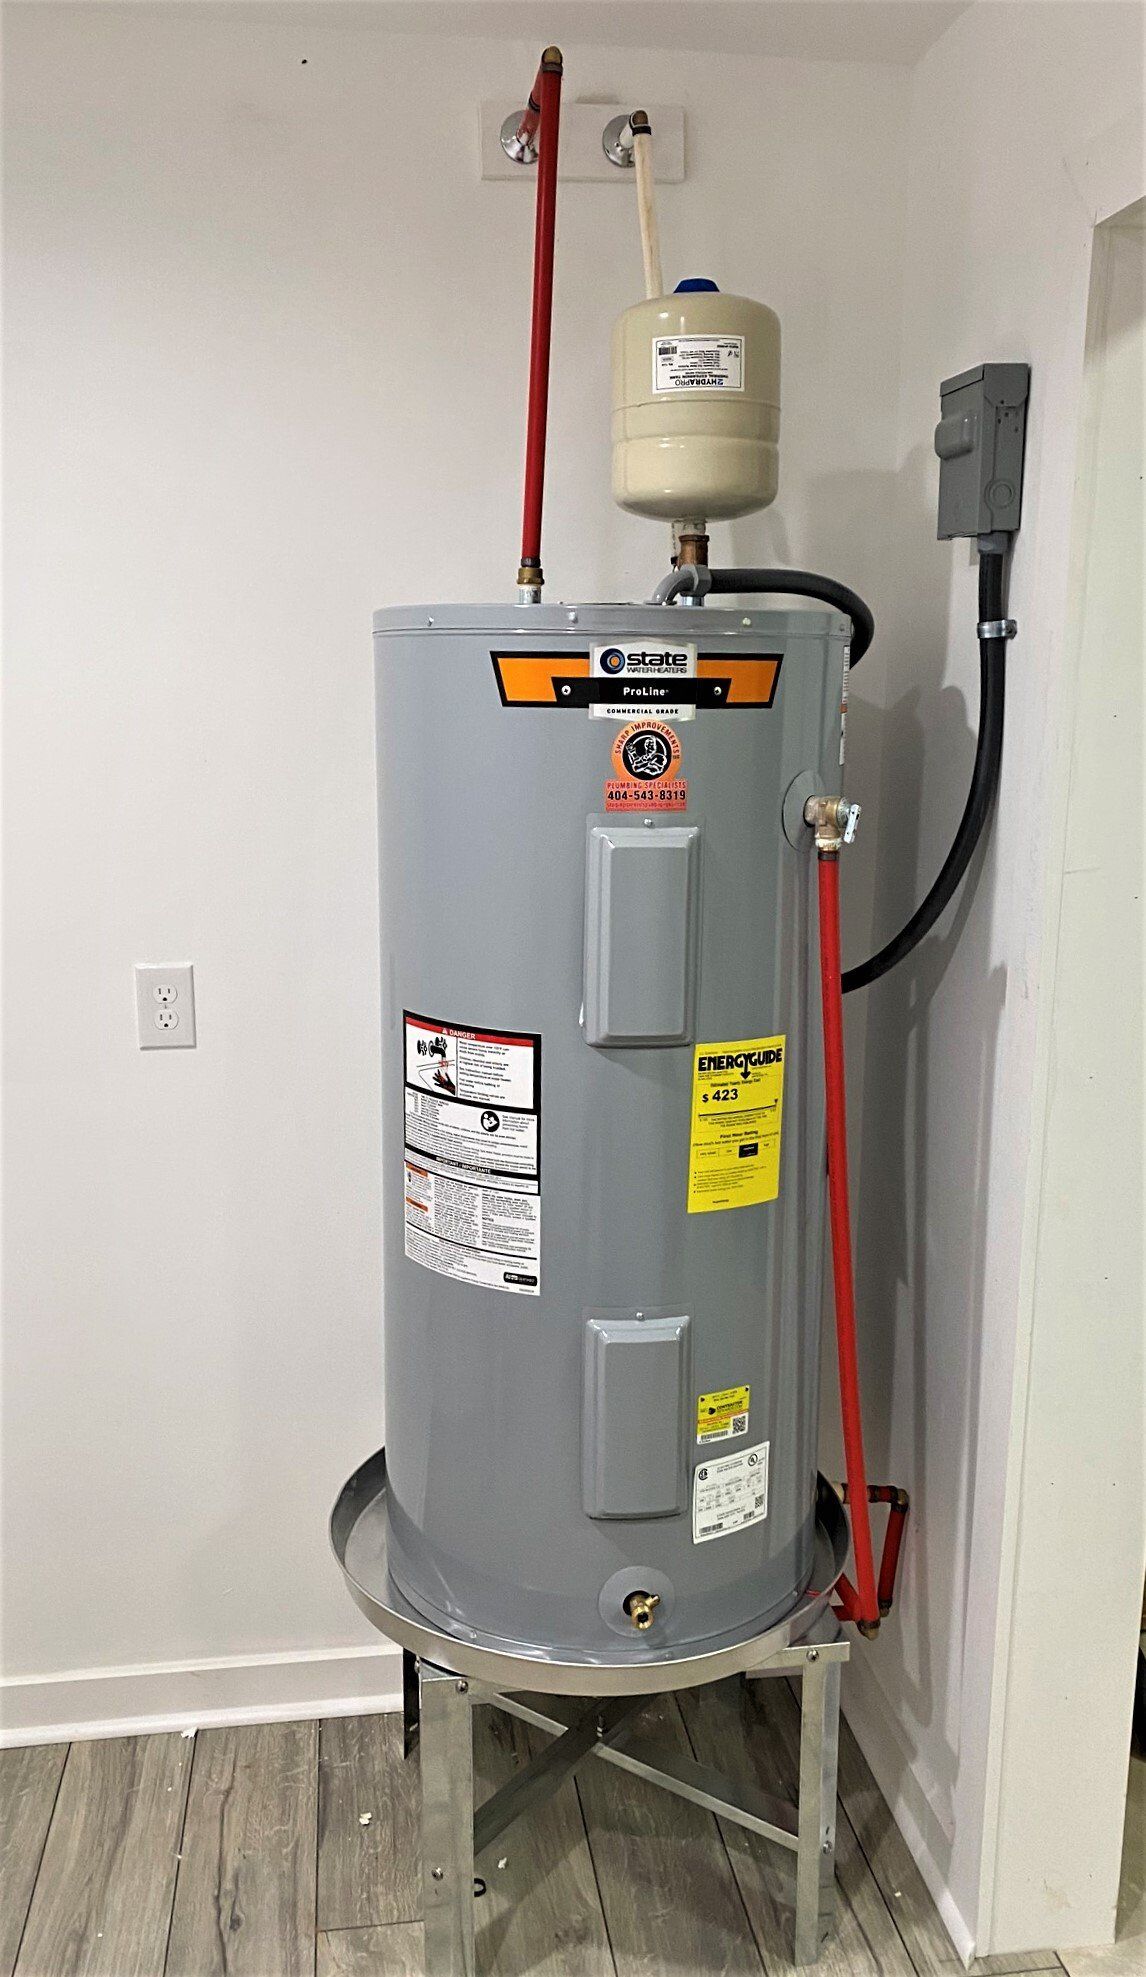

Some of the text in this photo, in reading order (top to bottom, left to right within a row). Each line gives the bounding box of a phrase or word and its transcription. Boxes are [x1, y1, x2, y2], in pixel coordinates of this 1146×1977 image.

[627, 651, 688, 666] state
[615, 721, 680, 754] SHARP IMPROVEMENTS
[607, 790, 686, 800] 404-543-8319
[449, 1030, 476, 1040] DANGER
[702, 1088, 738, 1103] $ 423
